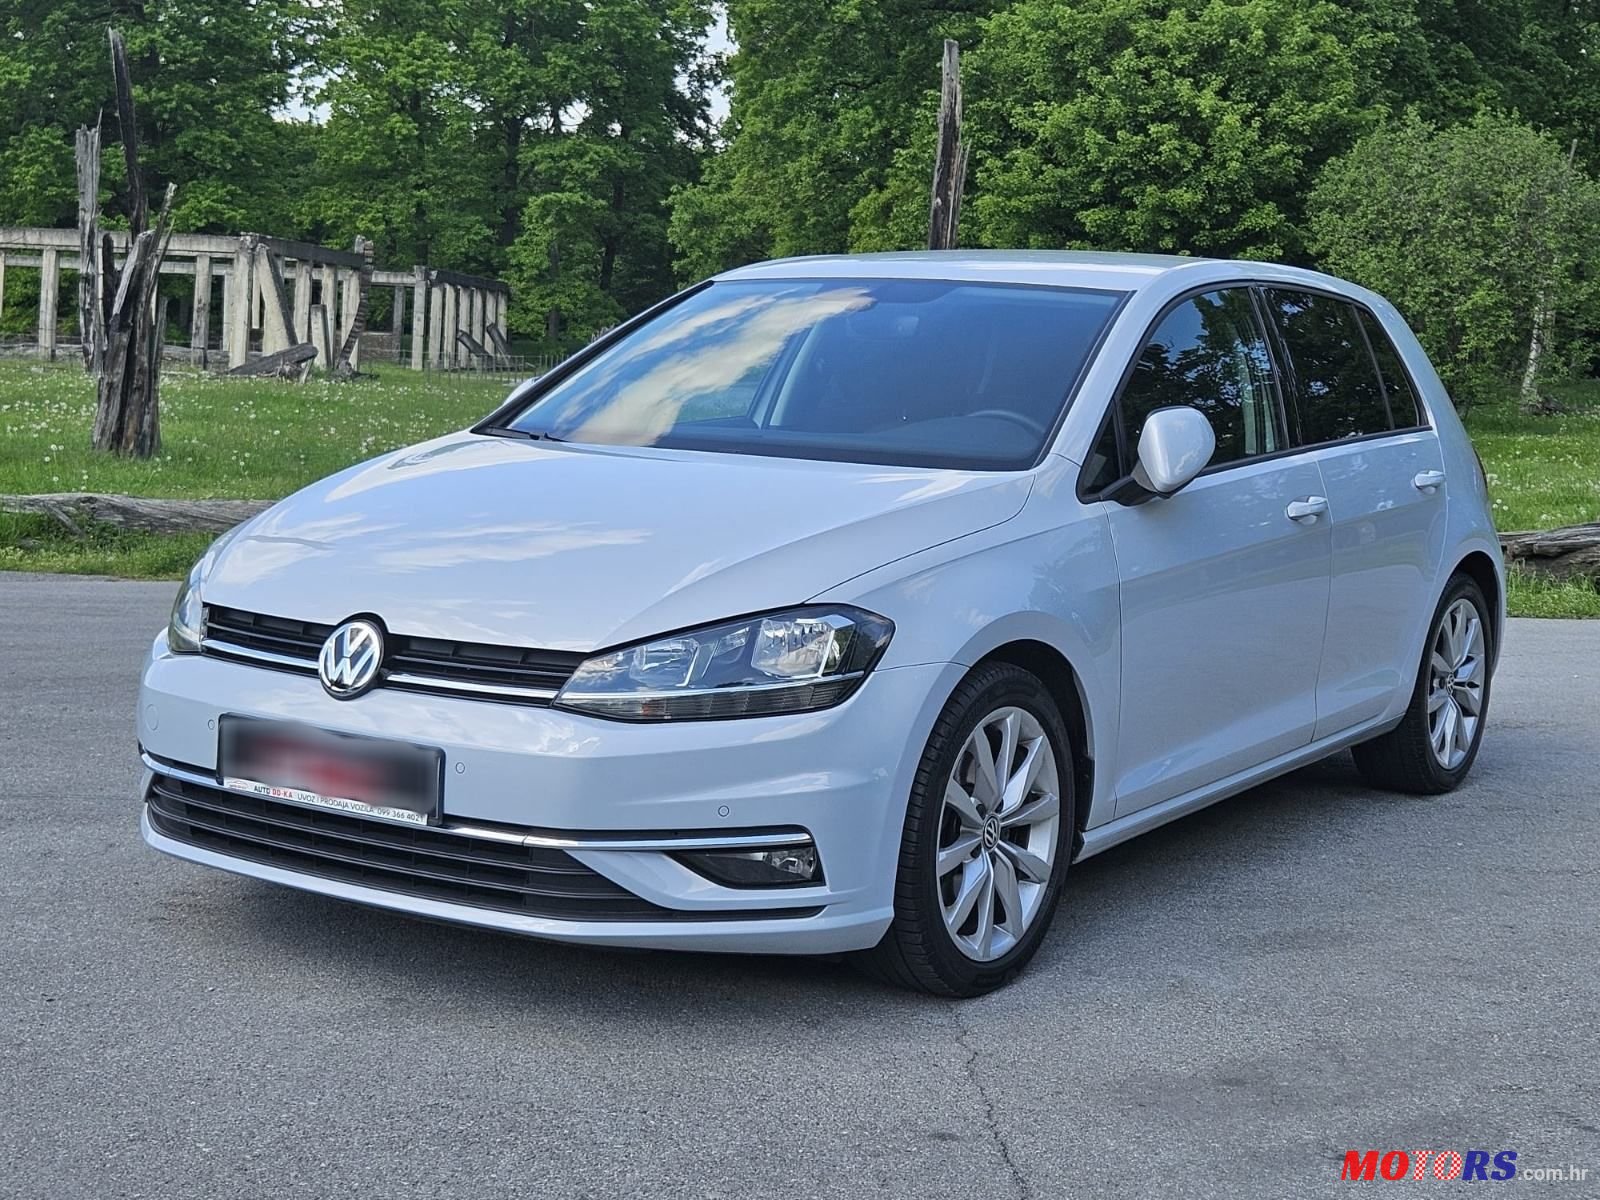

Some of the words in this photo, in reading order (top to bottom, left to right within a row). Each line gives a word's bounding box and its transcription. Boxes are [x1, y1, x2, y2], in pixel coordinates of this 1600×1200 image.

[319, 620, 379, 691] VW
[253, 785, 271, 795] AUTO
[297, 793, 315, 803] UVOZ
[320, 797, 349, 809] PRODAJA
[377, 807, 391, 816] 099
